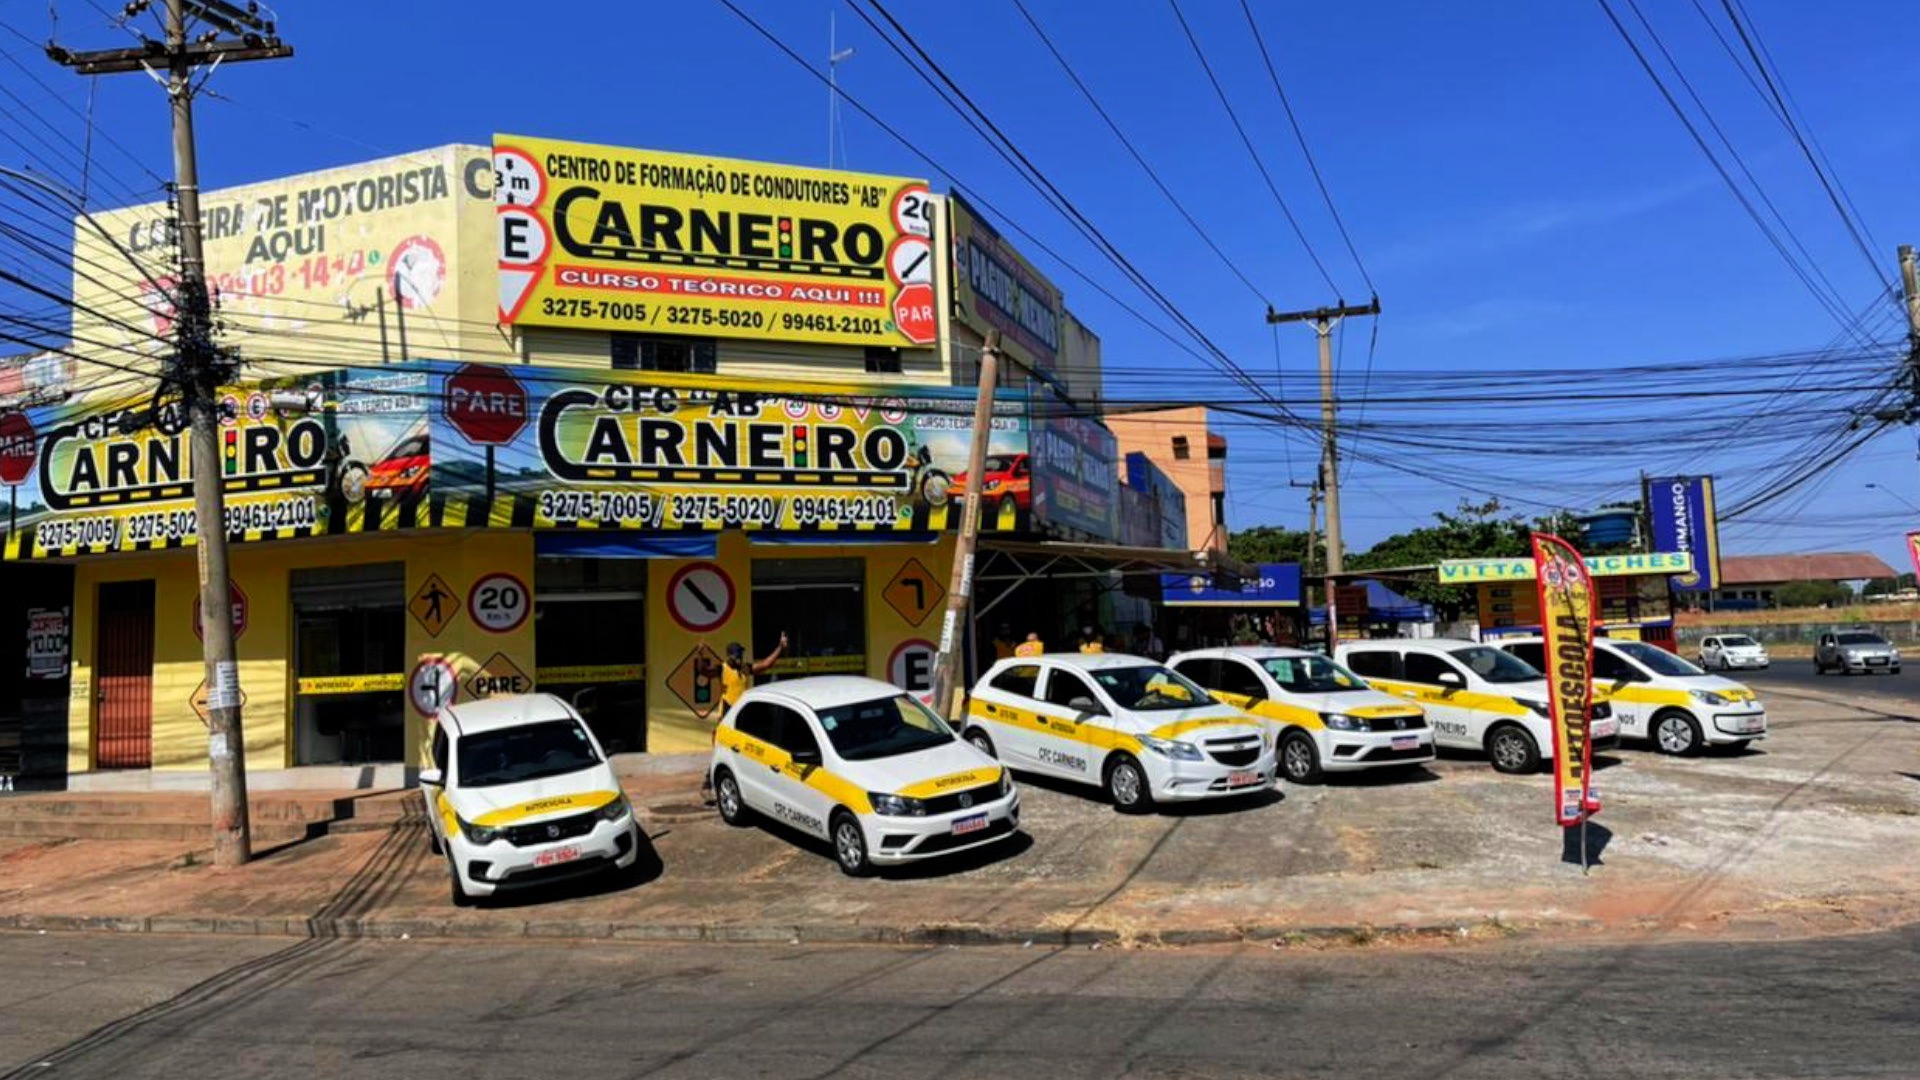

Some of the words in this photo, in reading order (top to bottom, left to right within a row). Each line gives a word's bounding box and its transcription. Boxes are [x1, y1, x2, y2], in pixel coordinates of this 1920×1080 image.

[299, 164, 448, 222] MOTORISTA
[511, 176, 530, 190] m
[546, 153, 610, 182] CENTRO
[615, 160, 636, 186] DE
[640, 163, 726, 198] FORMAÇÃO
[731, 171, 750, 196] DE
[753, 174, 850, 206] CONDUTORES
[504, 217, 529, 259] E
[553, 186, 884, 267] CARNEIRO
[245, 225, 325, 264] AQUI
[560, 270, 660, 290] CURSO
[667, 278, 783, 299] TEÓRICO
[790, 286, 850, 302] AQUI
[858, 291, 881, 304] !!!
[543, 298, 646, 322] 3275-7005
[650, 305, 661, 326] /
[666, 305, 763, 328] 3275-5020
[767, 313, 778, 332] /
[782, 312, 883, 335] 99461-2101
[450, 384, 524, 417] PARE
[604, 383, 679, 414] CFC
[538, 388, 906, 478] CARNEIRO
[542, 492, 651, 520] 3275-7005
[672, 495, 774, 523] 3275-5020
[793, 497, 898, 524] 99461-2101
[38, 518, 114, 548] 3275-7005
[128, 510, 197, 541] 3275-502
[1443, 563, 1527, 578] VITTA
[479, 587, 519, 610] 20
[476, 676, 522, 695] PARE
[904, 652, 931, 691] E
[1053, 751, 1087, 771] CARNEIRO
[787, 807, 823, 833] CARNEIRO
